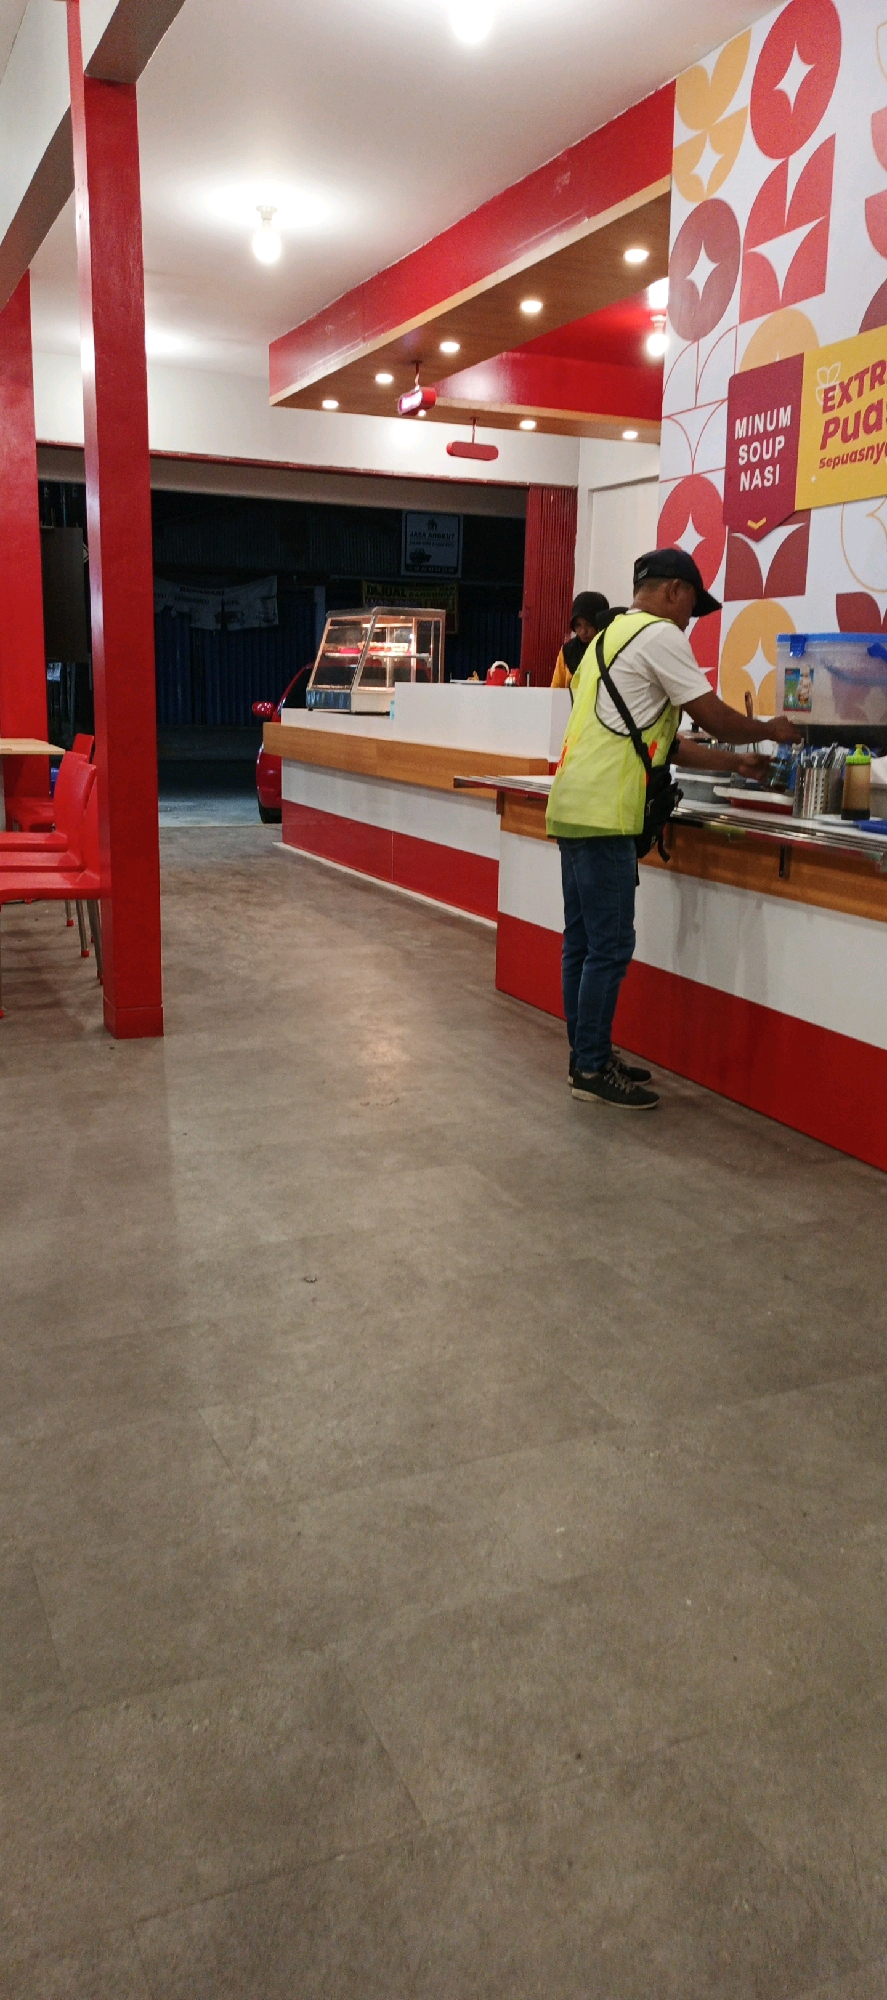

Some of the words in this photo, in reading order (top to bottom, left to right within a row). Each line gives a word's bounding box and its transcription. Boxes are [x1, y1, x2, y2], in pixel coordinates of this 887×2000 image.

[822, 359, 887, 414] EXTR
[734, 405, 792, 440] MINUM
[819, 398, 887, 450] Pua
[738, 435, 785, 466] SOUP
[819, 441, 887, 470] sepuasny
[739, 464, 780, 492] NASI
